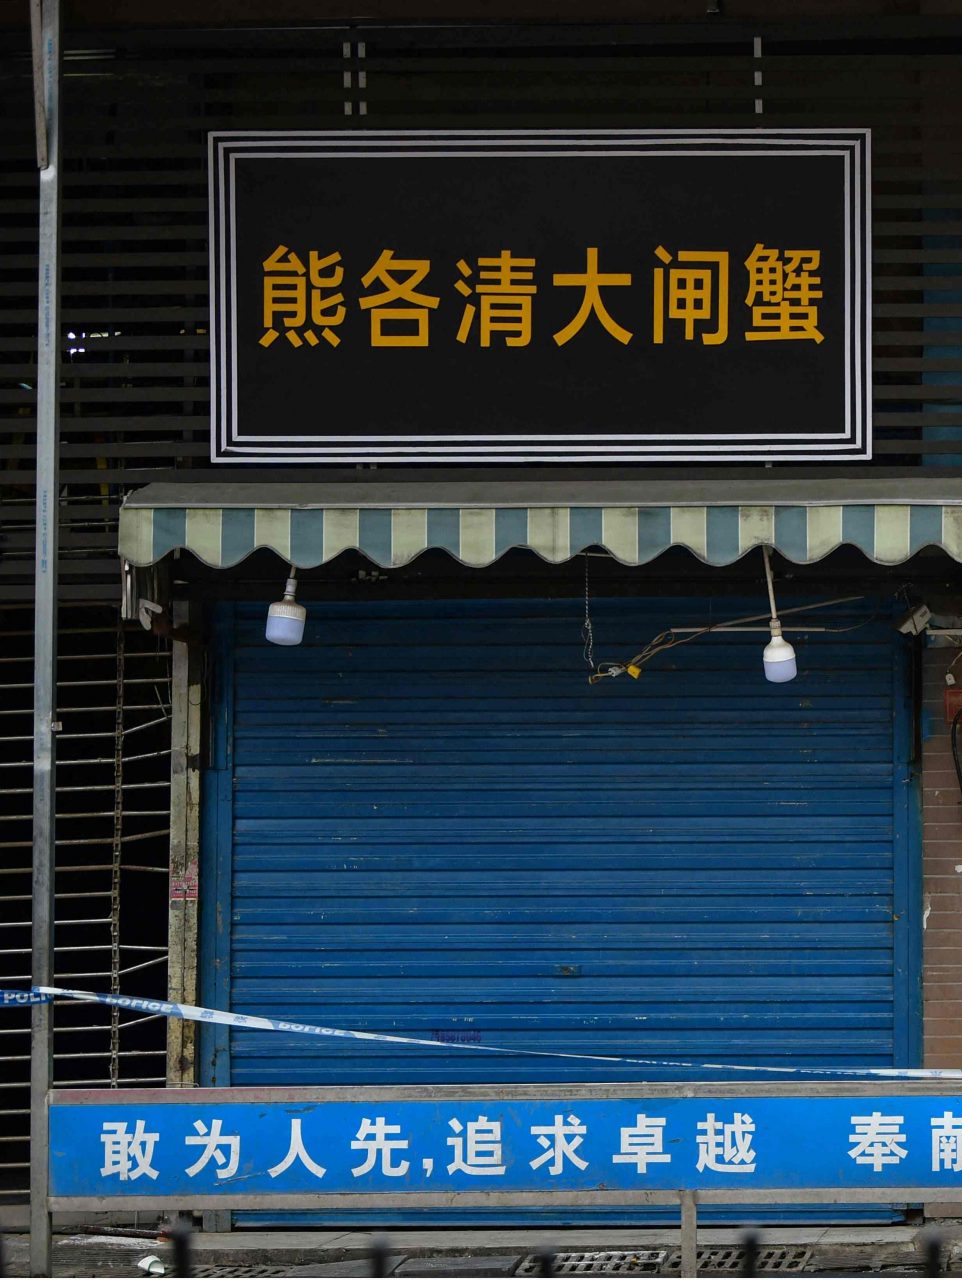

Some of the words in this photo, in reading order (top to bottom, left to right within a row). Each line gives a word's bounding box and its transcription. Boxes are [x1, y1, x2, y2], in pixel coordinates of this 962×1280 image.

[258, 243, 825, 349] 熊各清大闸蟹
